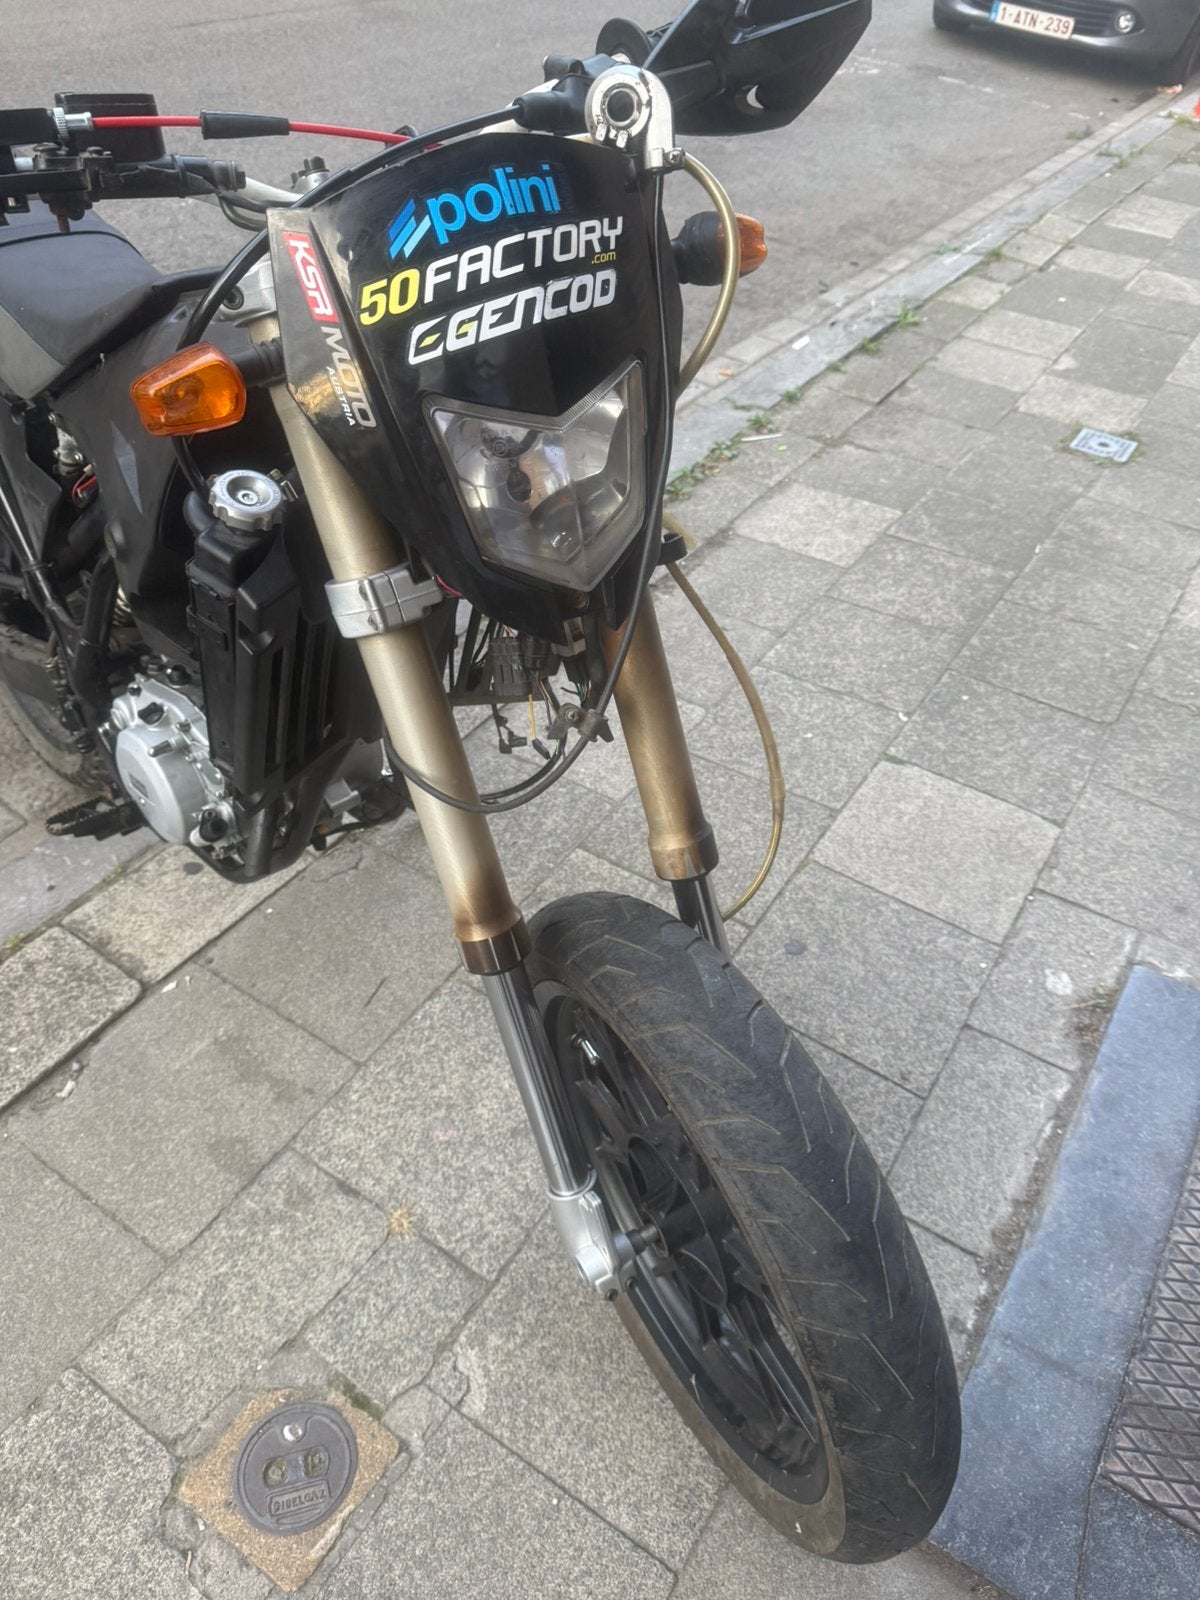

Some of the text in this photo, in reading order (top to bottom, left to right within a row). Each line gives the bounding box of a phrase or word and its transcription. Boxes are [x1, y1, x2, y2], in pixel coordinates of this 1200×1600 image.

[1001, 6, 1071, 34] 1-ATN-239
[426, 163, 560, 245] polini
[288, 238, 334, 317] KSR
[320, 325, 377, 428] MOTO
[325, 366, 356, 427] AUSTRIA
